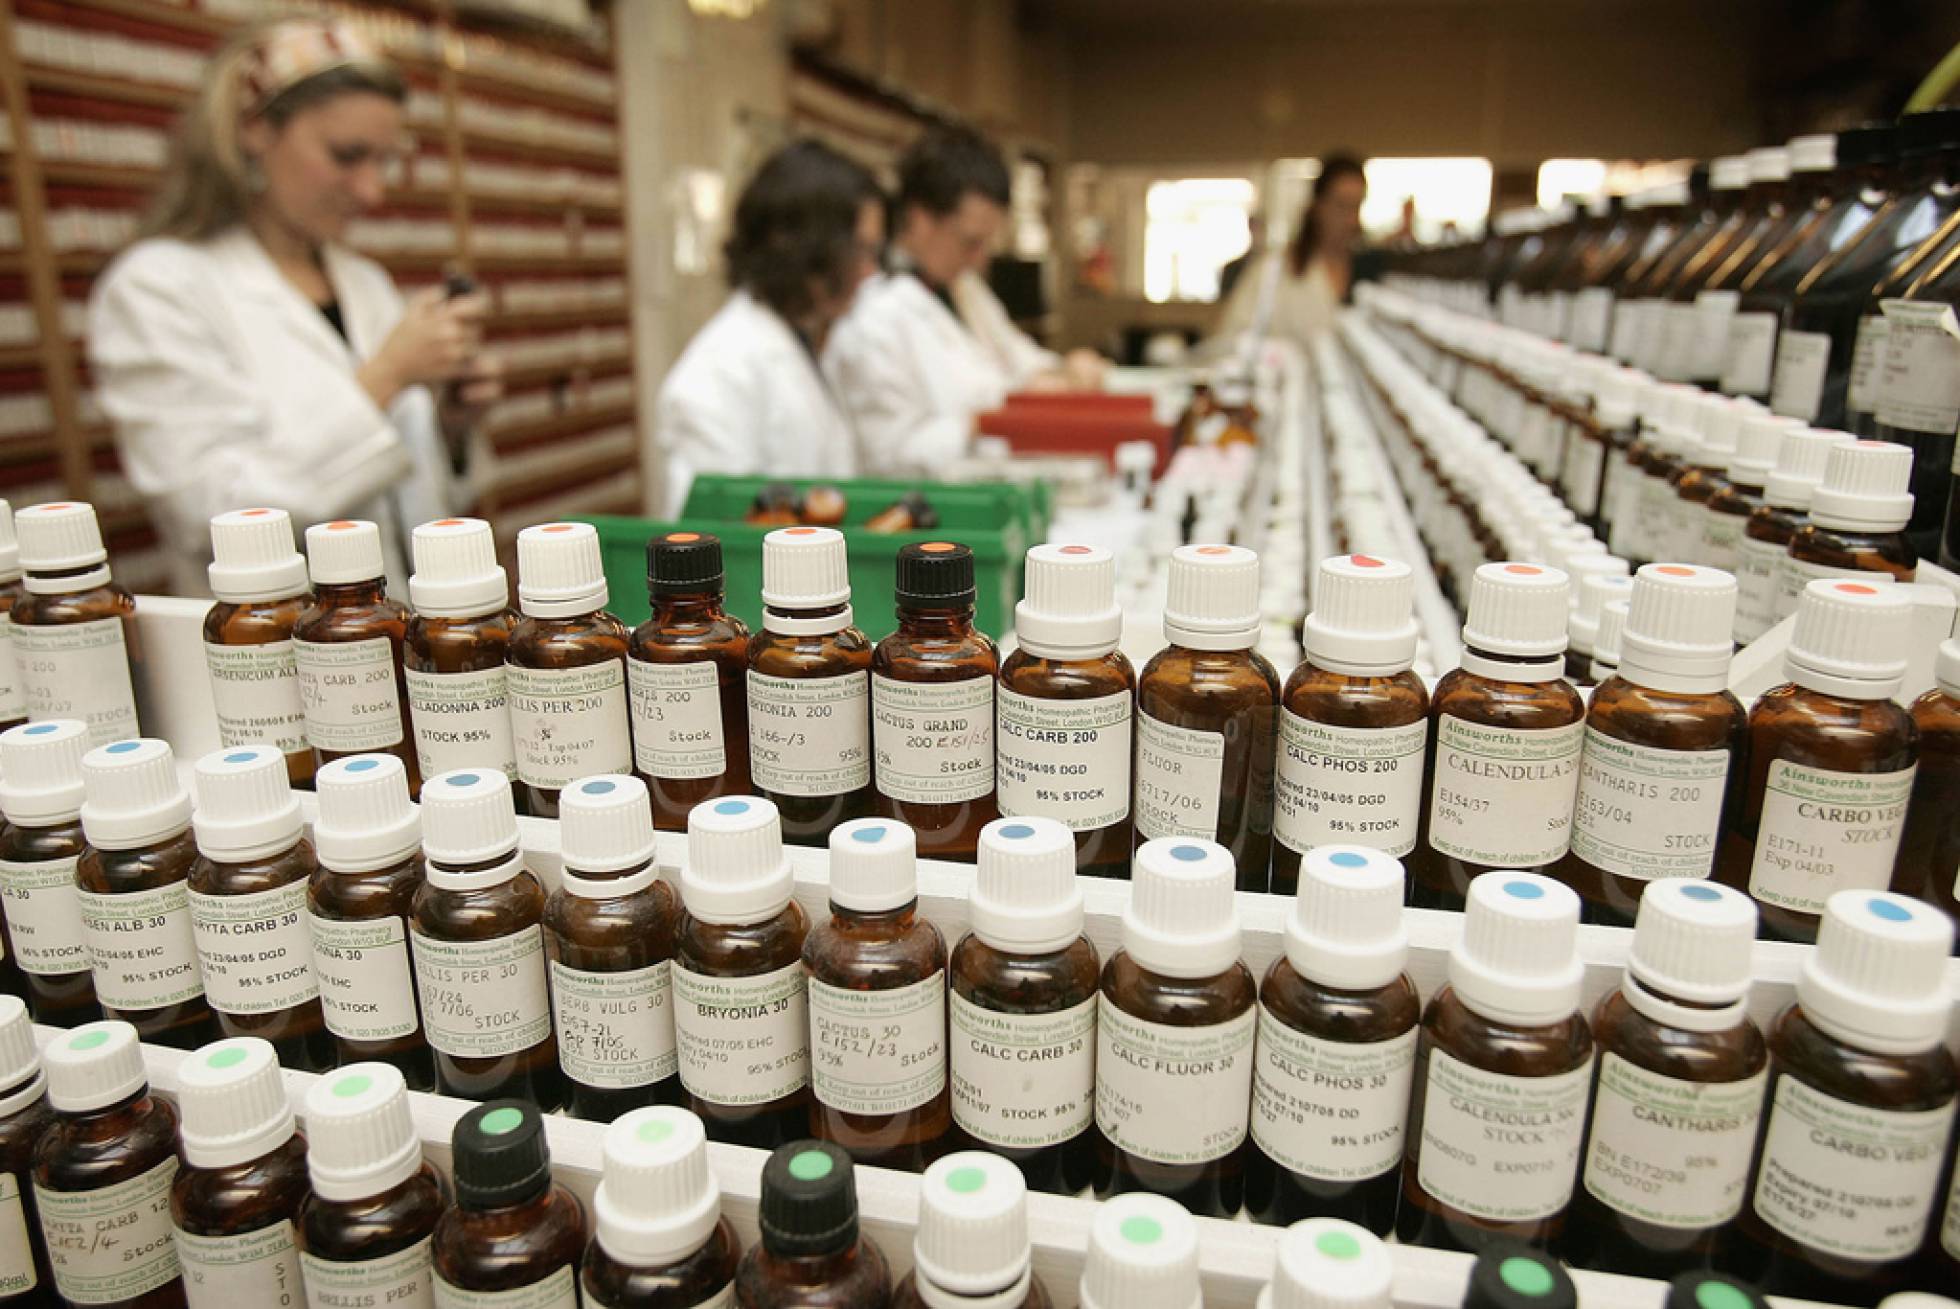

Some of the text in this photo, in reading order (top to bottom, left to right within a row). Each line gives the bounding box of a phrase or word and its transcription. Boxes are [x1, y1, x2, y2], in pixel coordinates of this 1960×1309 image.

[323, 669, 390, 687] CARB 200
[543, 696, 602, 714] PER 200
[666, 691, 690, 703] 200
[351, 700, 394, 715] Stock
[806, 704, 832, 718] 200
[922, 718, 969, 732] GRAND
[1446, 719, 1522, 745] Ainsworths
[421, 729, 492, 742] STOCK 95%
[668, 730, 712, 743] Stock
[905, 735, 932, 748] 200
[1026, 728, 1068, 744] CARB
[1072, 730, 1098, 744] 200
[940, 758, 982, 773] Stock
[1142, 749, 1182, 775] FLUOR
[1286, 744, 1399, 774] CALC PHOS 200
[1447, 752, 1561, 781] CALENDULA
[1059, 764, 1088, 775] DGD
[1779, 765, 1872, 791] Ainsworths
[1583, 761, 1700, 802] CANTHARIS 200
[1036, 787, 1105, 802] 95% STOCK
[1306, 787, 1386, 806] 23/04/05 DGD
[1438, 805, 1464, 825] 95%
[1797, 801, 1872, 825] CARBO
[1329, 818, 1400, 833] 95% STOCK
[1664, 832, 1712, 849] STOCK
[1767, 832, 1825, 860] E171-11
[1763, 850, 1792, 872] Exp
[114, 915, 166, 933] ALB 30
[195, 913, 298, 936] RYTA CARB 30
[41, 944, 83, 959] STOCK
[137, 946, 166, 959] EHC
[258, 947, 287, 962] DGD
[346, 950, 363, 961] 30
[149, 962, 192, 982] STOCK
[239, 976, 262, 988] 95%
[266, 964, 308, 984] STOCK
[462, 963, 518, 984] PER 30
[338, 1000, 379, 1014] STOCK
[599, 1000, 637, 1015] VULG
[647, 993, 664, 1009] 30
[697, 997, 789, 1020] BRYONIA 30
[474, 1009, 520, 1030] STOCK
[816, 1016, 871, 1040] CACTUS
[746, 1035, 774, 1050] EHC
[970, 1038, 1084, 1062] CALC CARB 30
[593, 1047, 639, 1061] STOCK
[900, 1040, 939, 1067] Stock
[1111, 1041, 1150, 1070] CALC
[1154, 1060, 1215, 1077] FLUOR
[746, 1062, 773, 1076] 95%
[1268, 1051, 1388, 1091] CALC PHOS 30
[1001, 1107, 1048, 1121] STOCK
[1449, 1096, 1553, 1126] CALENDULA
[1330, 1134, 1359, 1147] 95%
[1483, 1126, 1545, 1146] STOCK
[1808, 1129, 1889, 1162] CARBO
[1768, 1156, 1834, 1198] Prepared
[96, 1211, 139, 1234] CARB
[123, 1230, 173, 1263] Stock
[385, 1281, 417, 1305] PER
